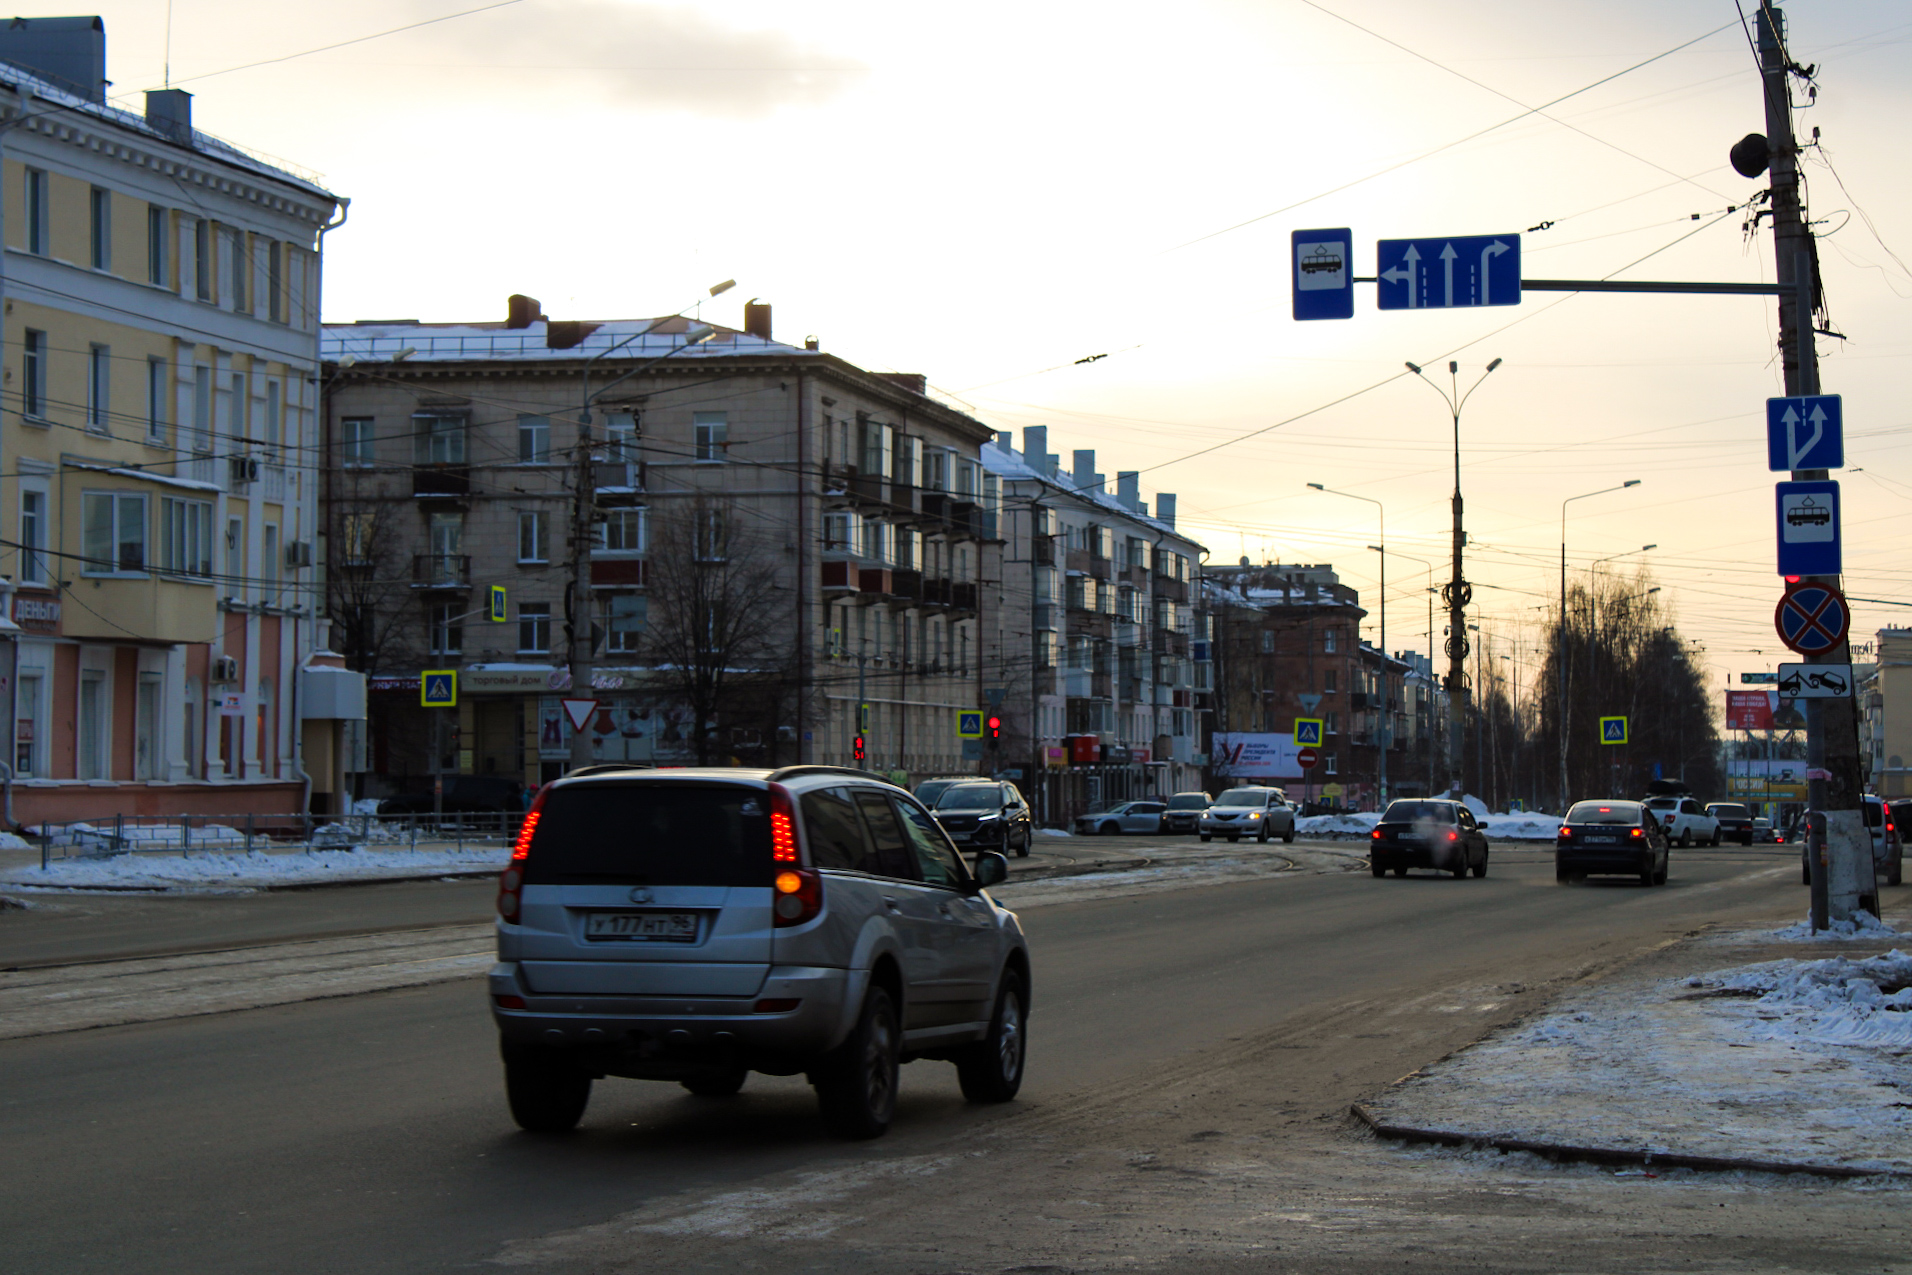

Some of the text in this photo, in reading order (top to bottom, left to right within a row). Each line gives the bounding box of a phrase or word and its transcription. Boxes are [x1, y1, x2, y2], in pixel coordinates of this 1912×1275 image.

[16, 600, 61, 622] ДЕНЬГИ
[473, 675, 542, 686] торговый дом
